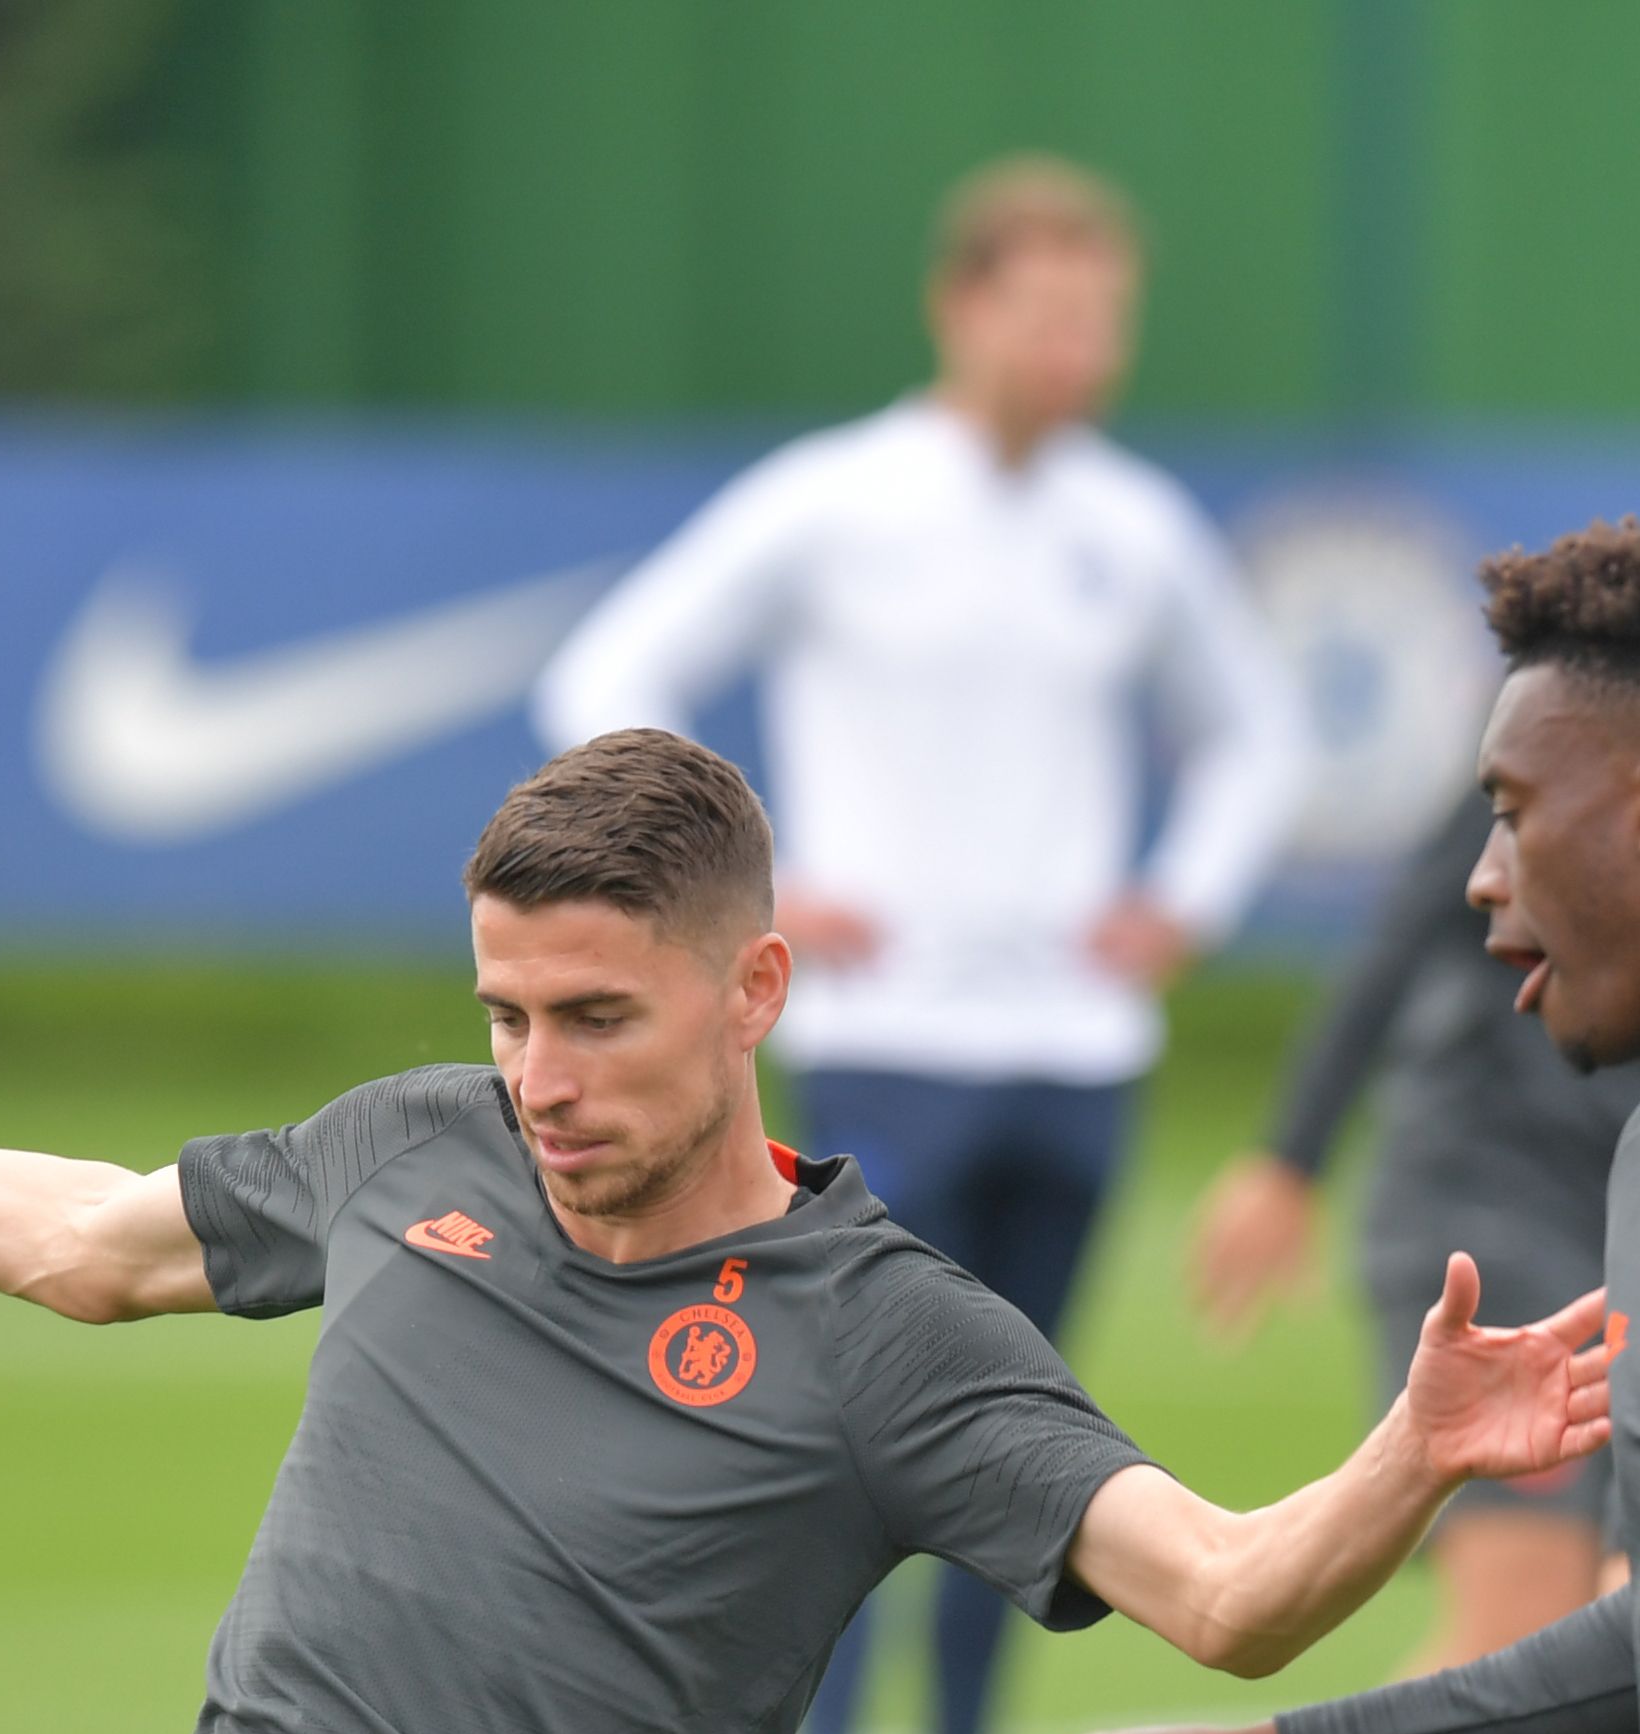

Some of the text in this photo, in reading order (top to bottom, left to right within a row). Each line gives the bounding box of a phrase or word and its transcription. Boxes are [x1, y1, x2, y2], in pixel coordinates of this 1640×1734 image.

[429, 1210, 494, 1248] NIKE
[713, 1257, 748, 1303] 5
[679, 1308, 745, 1338] CHELSEA
